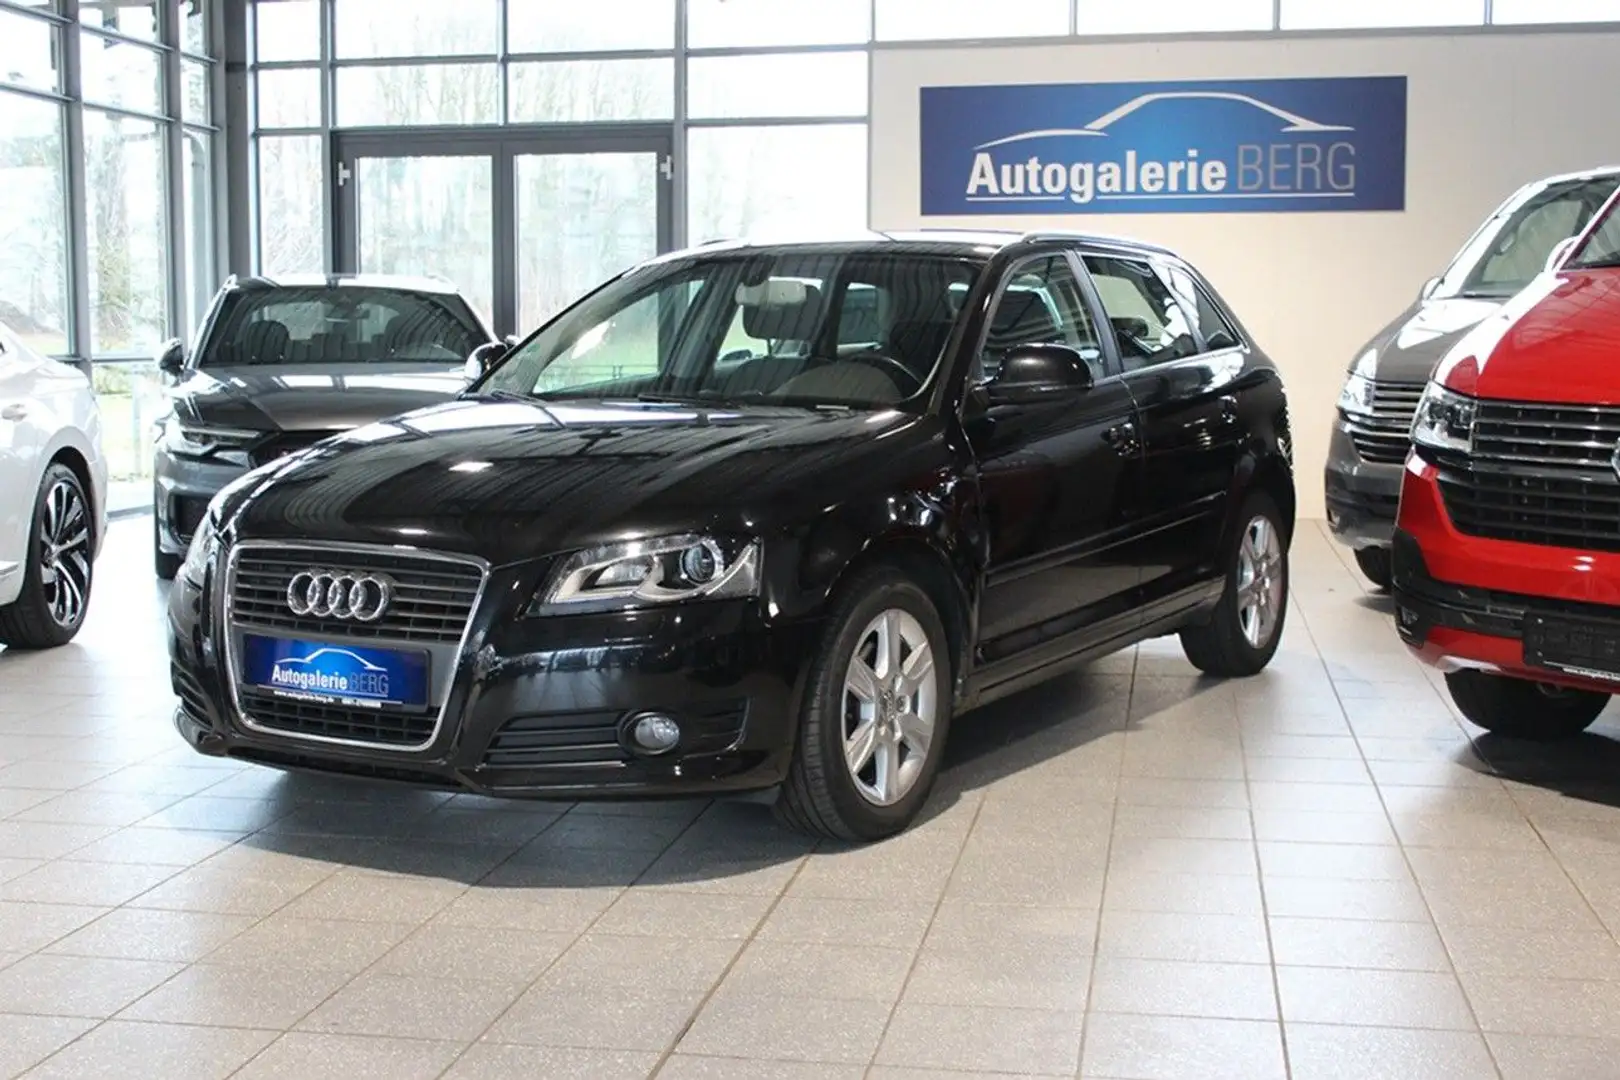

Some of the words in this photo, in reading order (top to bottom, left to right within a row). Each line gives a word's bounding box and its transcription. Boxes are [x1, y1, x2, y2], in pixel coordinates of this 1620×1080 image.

[967, 150, 1228, 204] Autogalerie
[1237, 143, 1356, 192] BERG
[271, 664, 348, 690] Autogalerie
[349, 672, 390, 695] BERG
